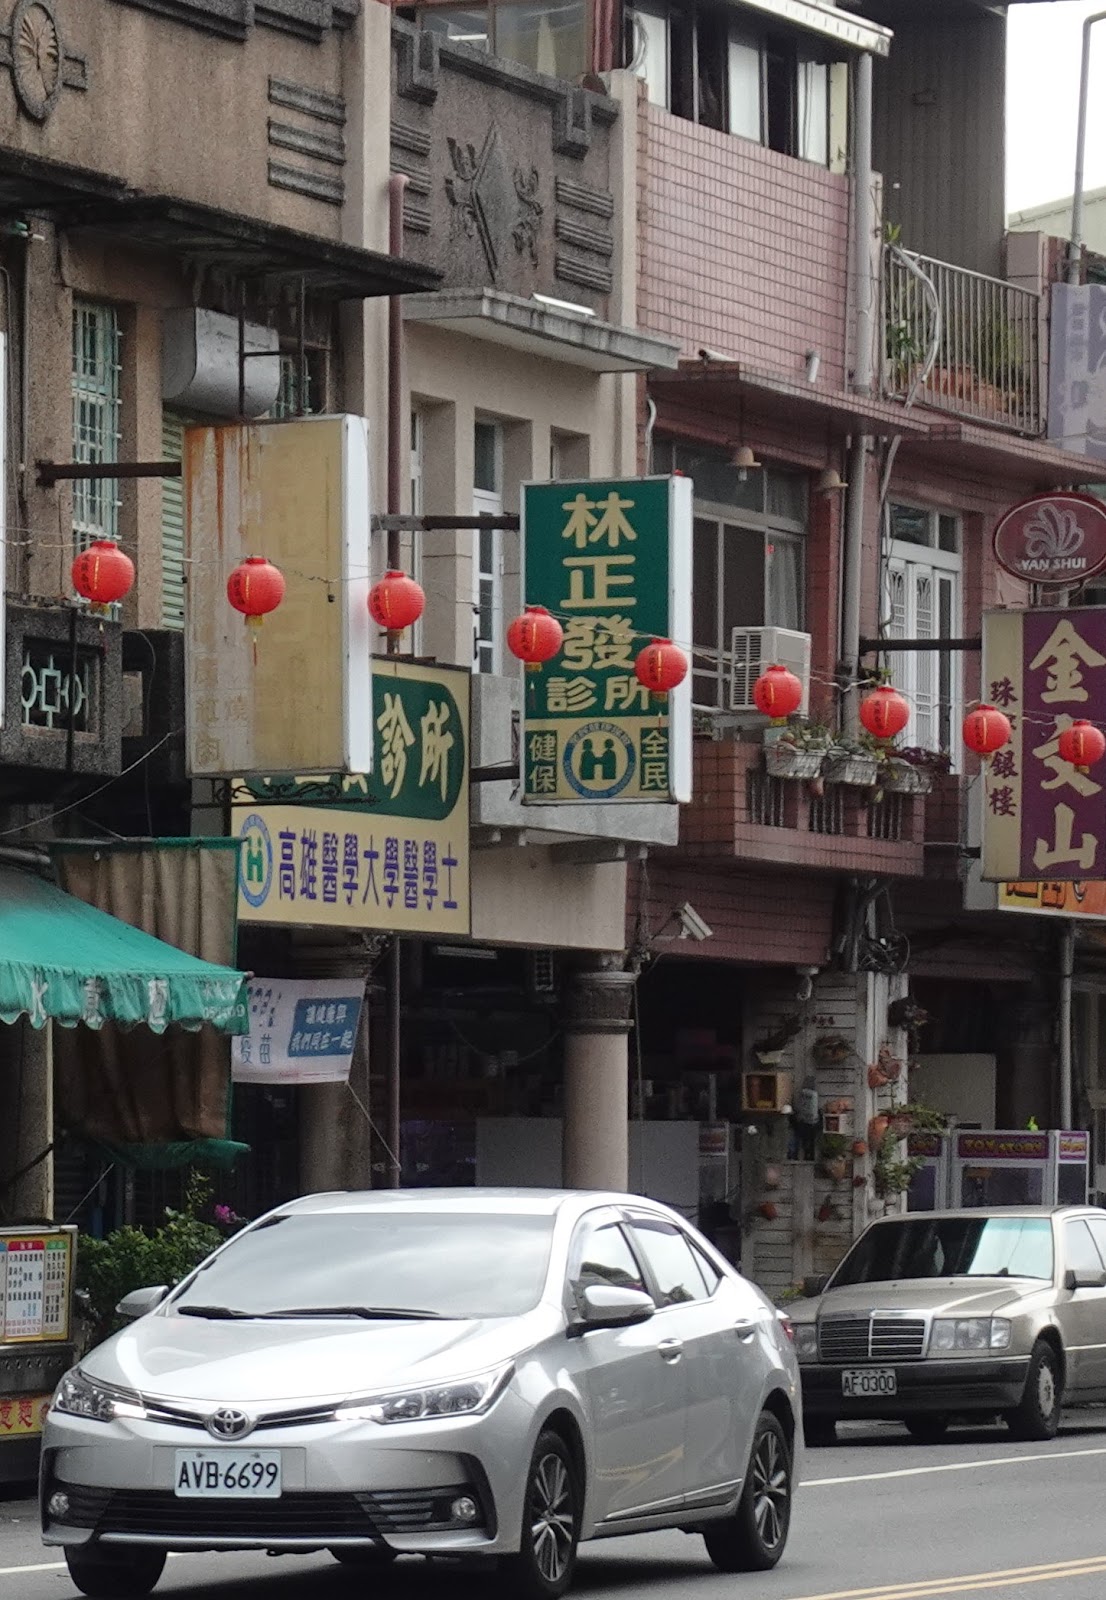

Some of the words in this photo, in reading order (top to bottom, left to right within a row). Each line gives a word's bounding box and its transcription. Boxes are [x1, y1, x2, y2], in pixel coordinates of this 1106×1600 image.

[561, 491, 638, 671] 林正發
[1020, 559, 1050, 571] YAN
[1052, 557, 1087, 570] SHUI
[546, 675, 650, 712] 診所
[529, 733, 557, 793] 健保
[641, 729, 669, 791] 全民
[989, 676, 1019, 817] 珠銀樓
[278, 826, 458, 911] 高雄醫學大學醫學士
[843, 1375, 895, 1393] AF-0300
[178, 1461, 278, 1489] AVB-6699
